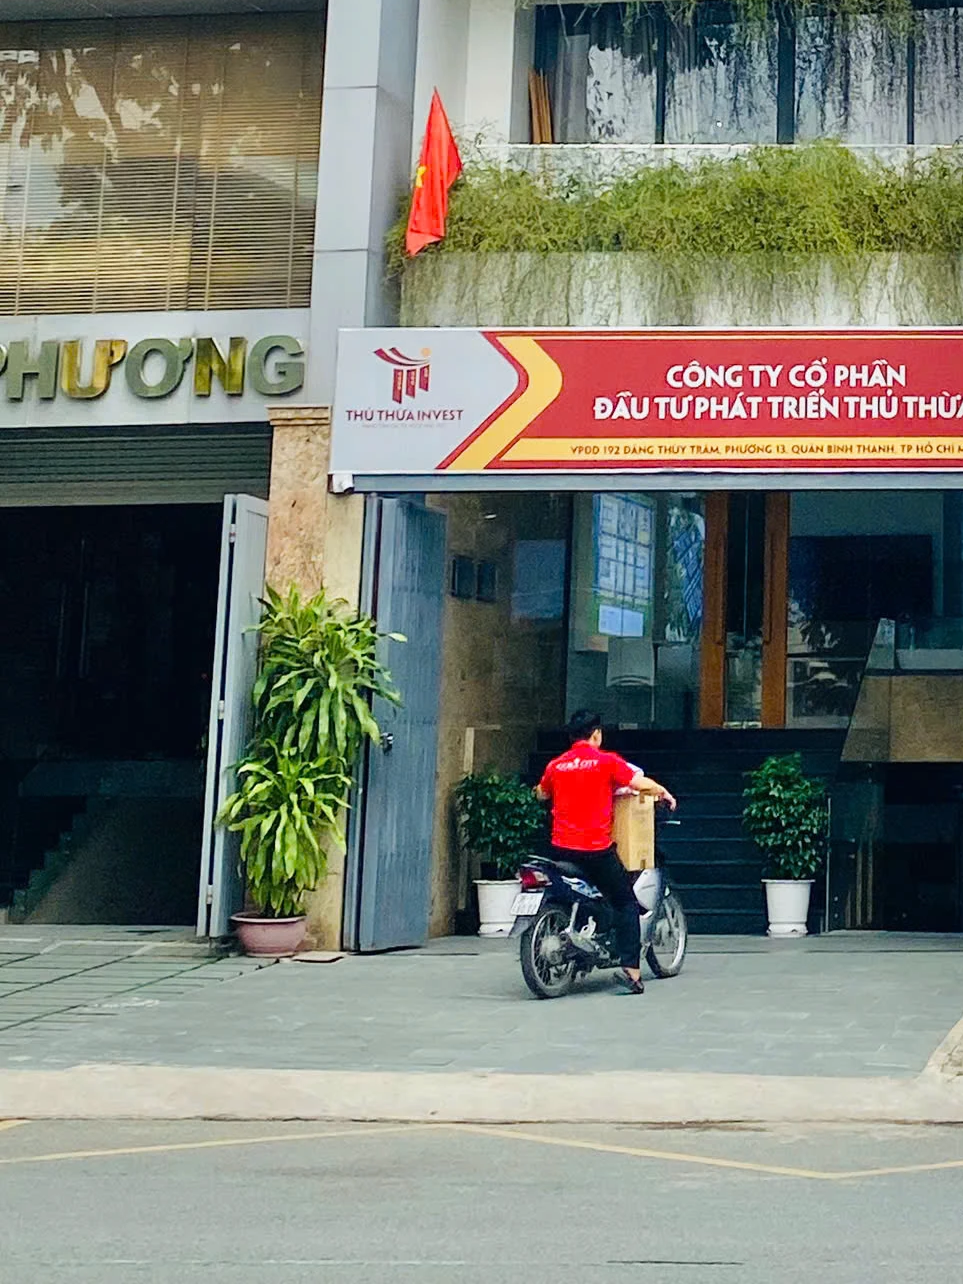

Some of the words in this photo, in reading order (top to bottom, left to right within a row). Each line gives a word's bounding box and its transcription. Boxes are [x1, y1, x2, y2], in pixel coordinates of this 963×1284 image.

[0, 335, 305, 401] HƯƠNG
[666, 360, 743, 388] CÔNG
[748, 365, 783, 388] TY
[788, 357, 828, 388] CỔ
[834, 359, 906, 388] PHẦN
[417, 409, 464, 421] INVEST
[593, 391, 650, 420] ĐẦU
[654, 395, 693, 420] TƯ
[695, 391, 762, 420] PHÁT
[766, 388, 839, 419] TRIỂN
[843, 388, 898, 419] THỦ
[603, 445, 620, 455] 192
